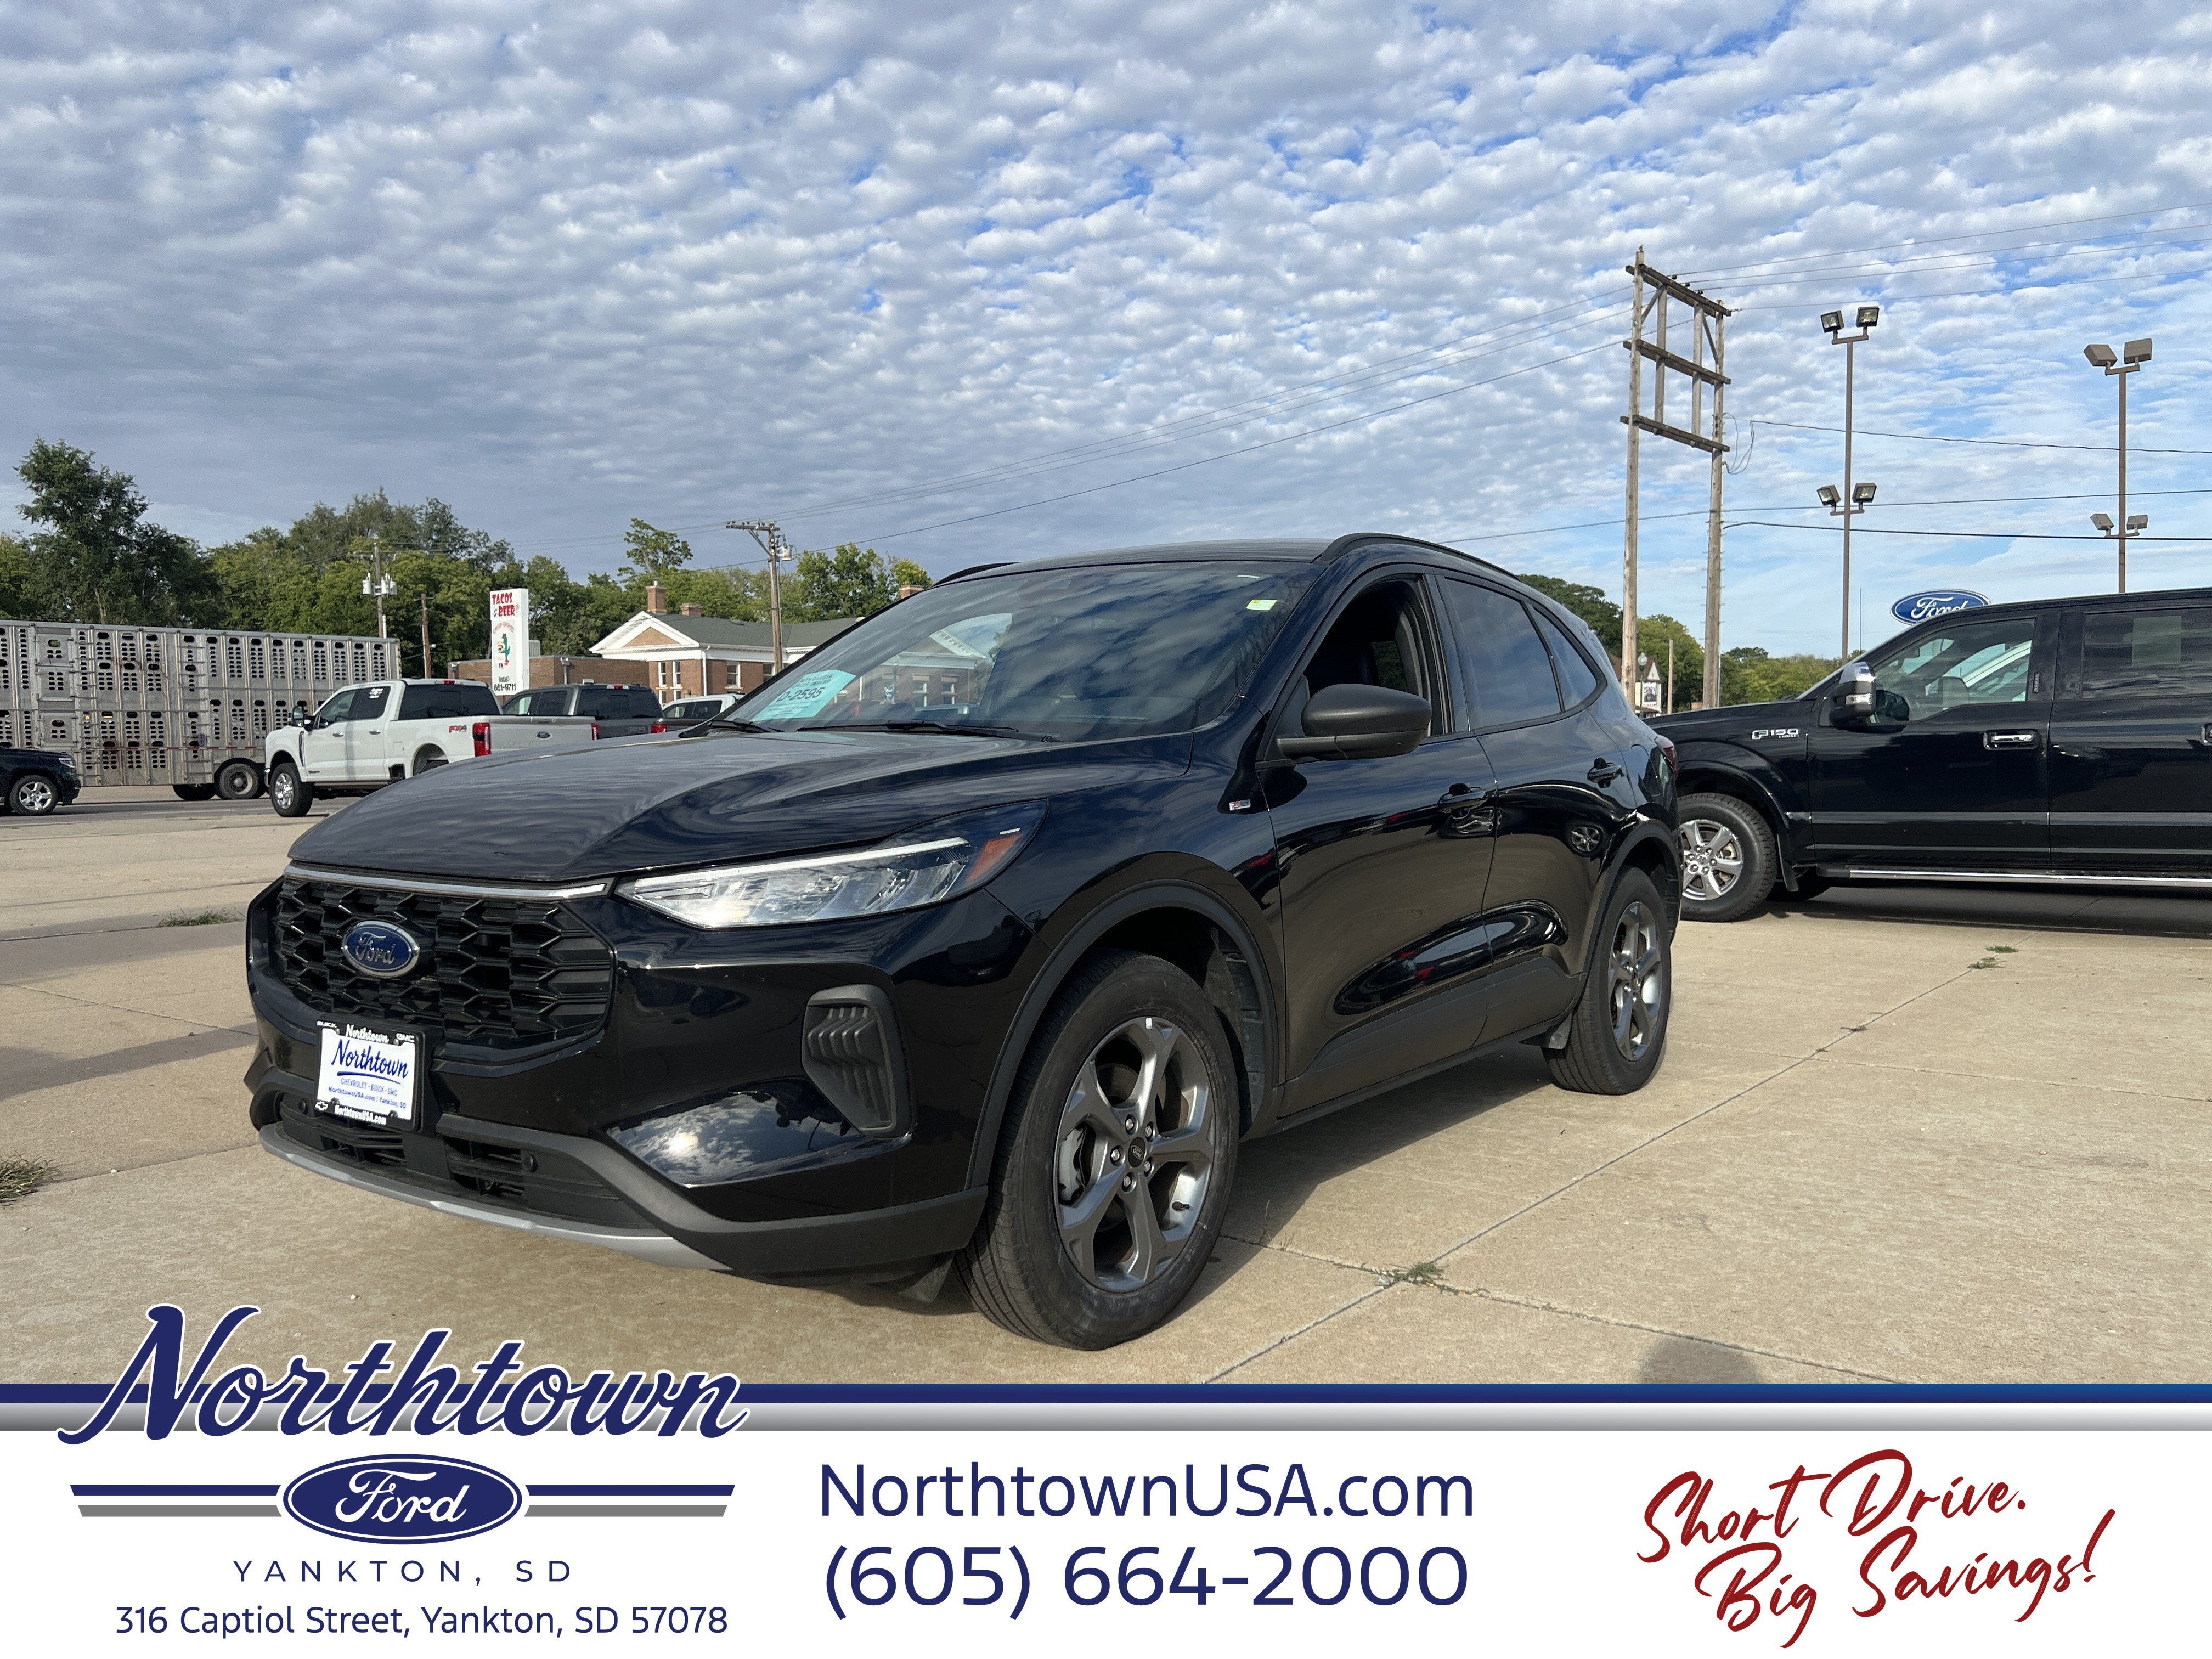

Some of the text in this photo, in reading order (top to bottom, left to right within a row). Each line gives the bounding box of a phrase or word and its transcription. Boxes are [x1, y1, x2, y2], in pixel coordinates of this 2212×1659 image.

[492, 592, 512, 605] TACOS
[498, 605, 515, 617] BEER
[775, 686, 826, 702] D-2595
[449, 725, 467, 733] FX4
[356, 932, 396, 964] Ford
[345, 1024, 390, 1043] Northtown
[331, 1039, 409, 1079] Northtown
[341, 1077, 367, 1089] CHEVROLET
[334, 1104, 387, 1125] NorthtownUSA.com
